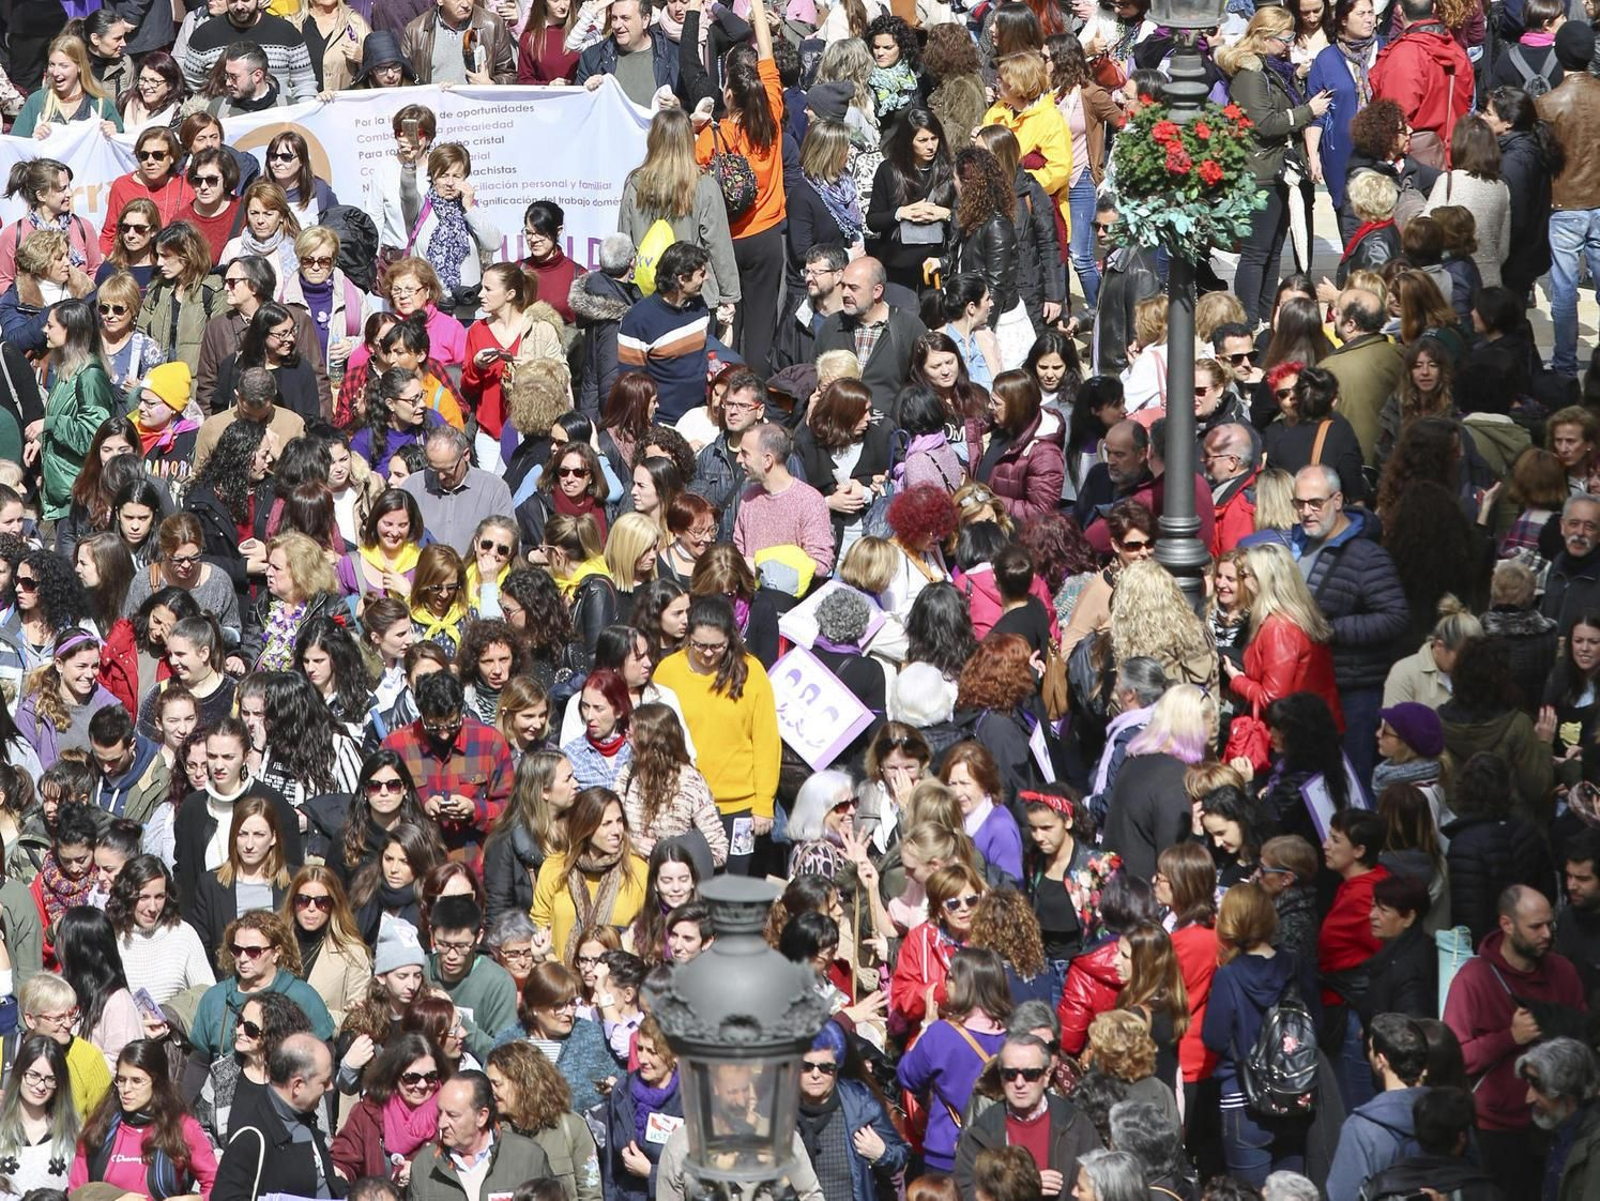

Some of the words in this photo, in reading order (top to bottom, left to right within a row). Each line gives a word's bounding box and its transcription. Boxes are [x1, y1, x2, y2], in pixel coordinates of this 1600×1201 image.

[355, 119, 371, 128] Por
[375, 116, 385, 125] la
[440, 111, 453, 119] de
[456, 104, 535, 120] oportunidades
[447, 120, 514, 135] precariedad
[359, 150, 382, 160] Para
[473, 135, 505, 146] cristal
[471, 166, 517, 177] achistas
[522, 179, 567, 191] personal
[570, 181, 576, 190] y
[579, 180, 612, 191] familiar
[558, 197, 590, 207] trabajo
